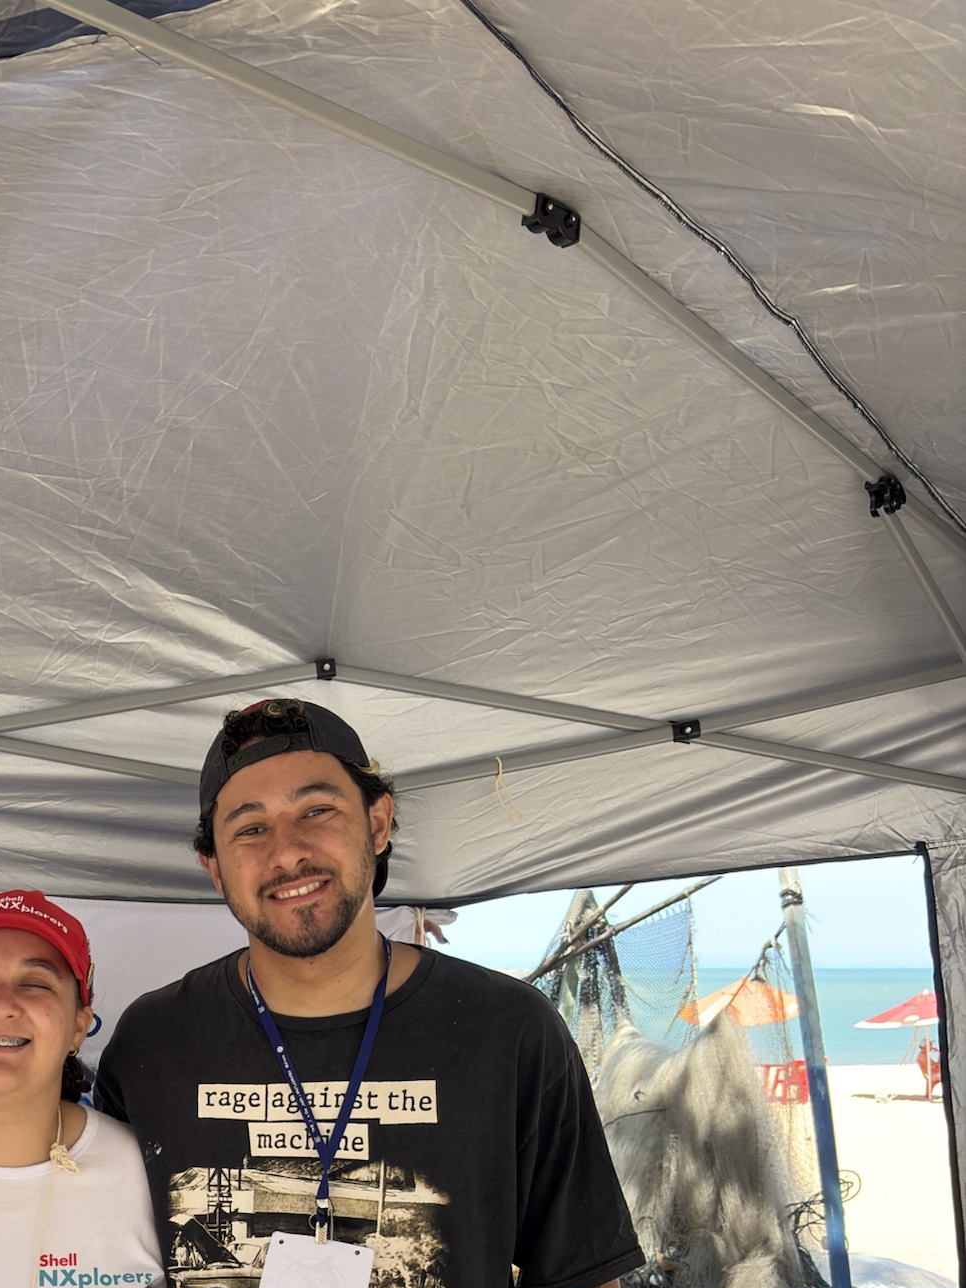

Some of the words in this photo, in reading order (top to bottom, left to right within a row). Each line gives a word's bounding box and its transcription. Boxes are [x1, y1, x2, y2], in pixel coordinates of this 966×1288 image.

[205, 1091, 261, 1114] rage
[271, 1087, 379, 1114] against
[387, 1089, 433, 1112] the
[257, 1129, 365, 1152] machine
[39, 1253, 77, 1267] Shell
